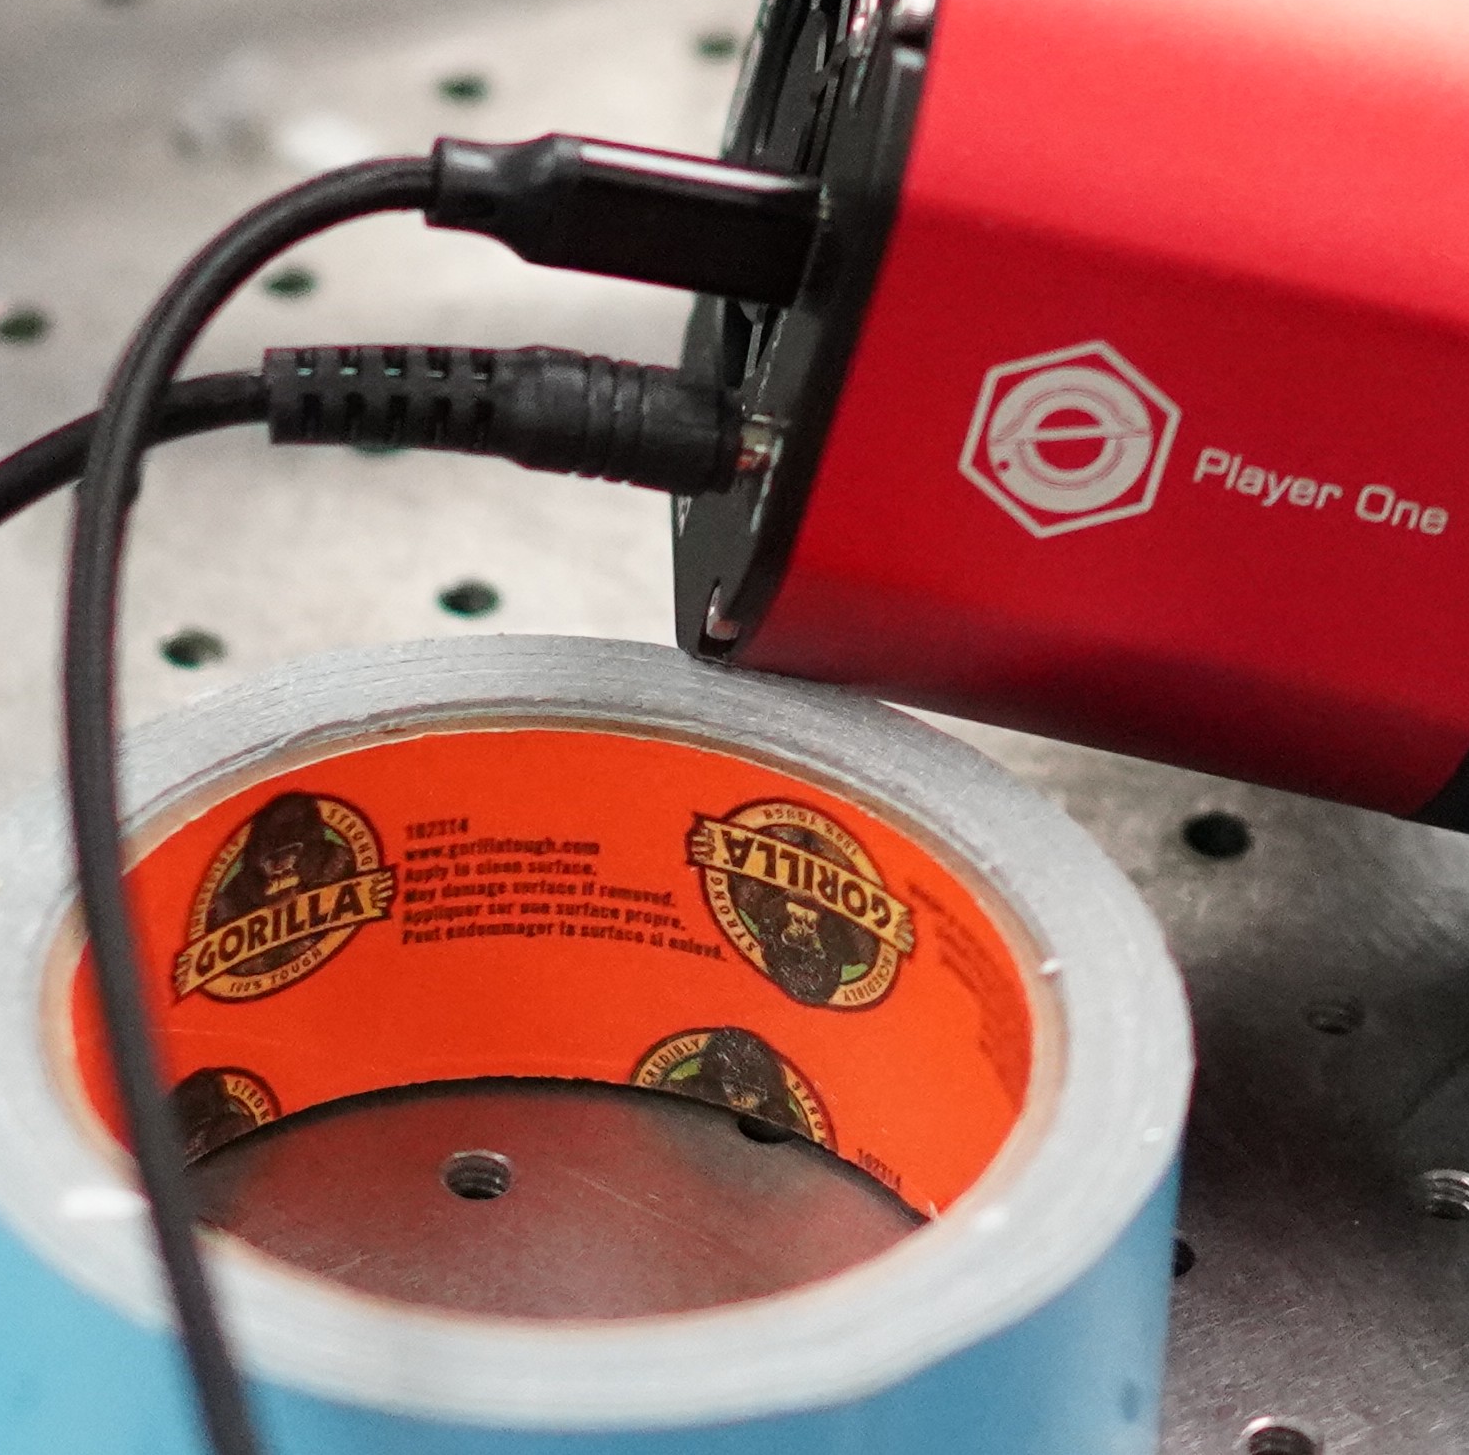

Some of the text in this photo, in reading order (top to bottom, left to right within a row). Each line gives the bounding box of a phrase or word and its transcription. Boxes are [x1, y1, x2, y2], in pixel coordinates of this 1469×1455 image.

[1192, 446, 1449, 535] Player One
[326, 807, 373, 867] STRONG
[404, 836, 600, 861] www.gorillatough.com
[404, 865, 448, 883] Apply
[476, 859, 522, 876] clean
[528, 860, 597, 877] surface.
[721, 830, 892, 929] GORILLA
[404, 888, 436, 904] May
[441, 881, 507, 898] damage
[513, 880, 576, 895] surface
[599, 885, 677, 907] removed.
[710, 876, 758, 953] STRONG
[195, 883, 364, 978] GORILLA
[446, 922, 553, 941] endommager
[580, 925, 644, 943] surface
[487, 902, 513, 915] sur
[556, 902, 620, 920] surface
[625, 909, 686, 931] propre.
[270, 947, 323, 985] TOUGH
[641, 1037, 702, 1087] CREDIBLY
[231, 1079, 271, 1122] STRON
